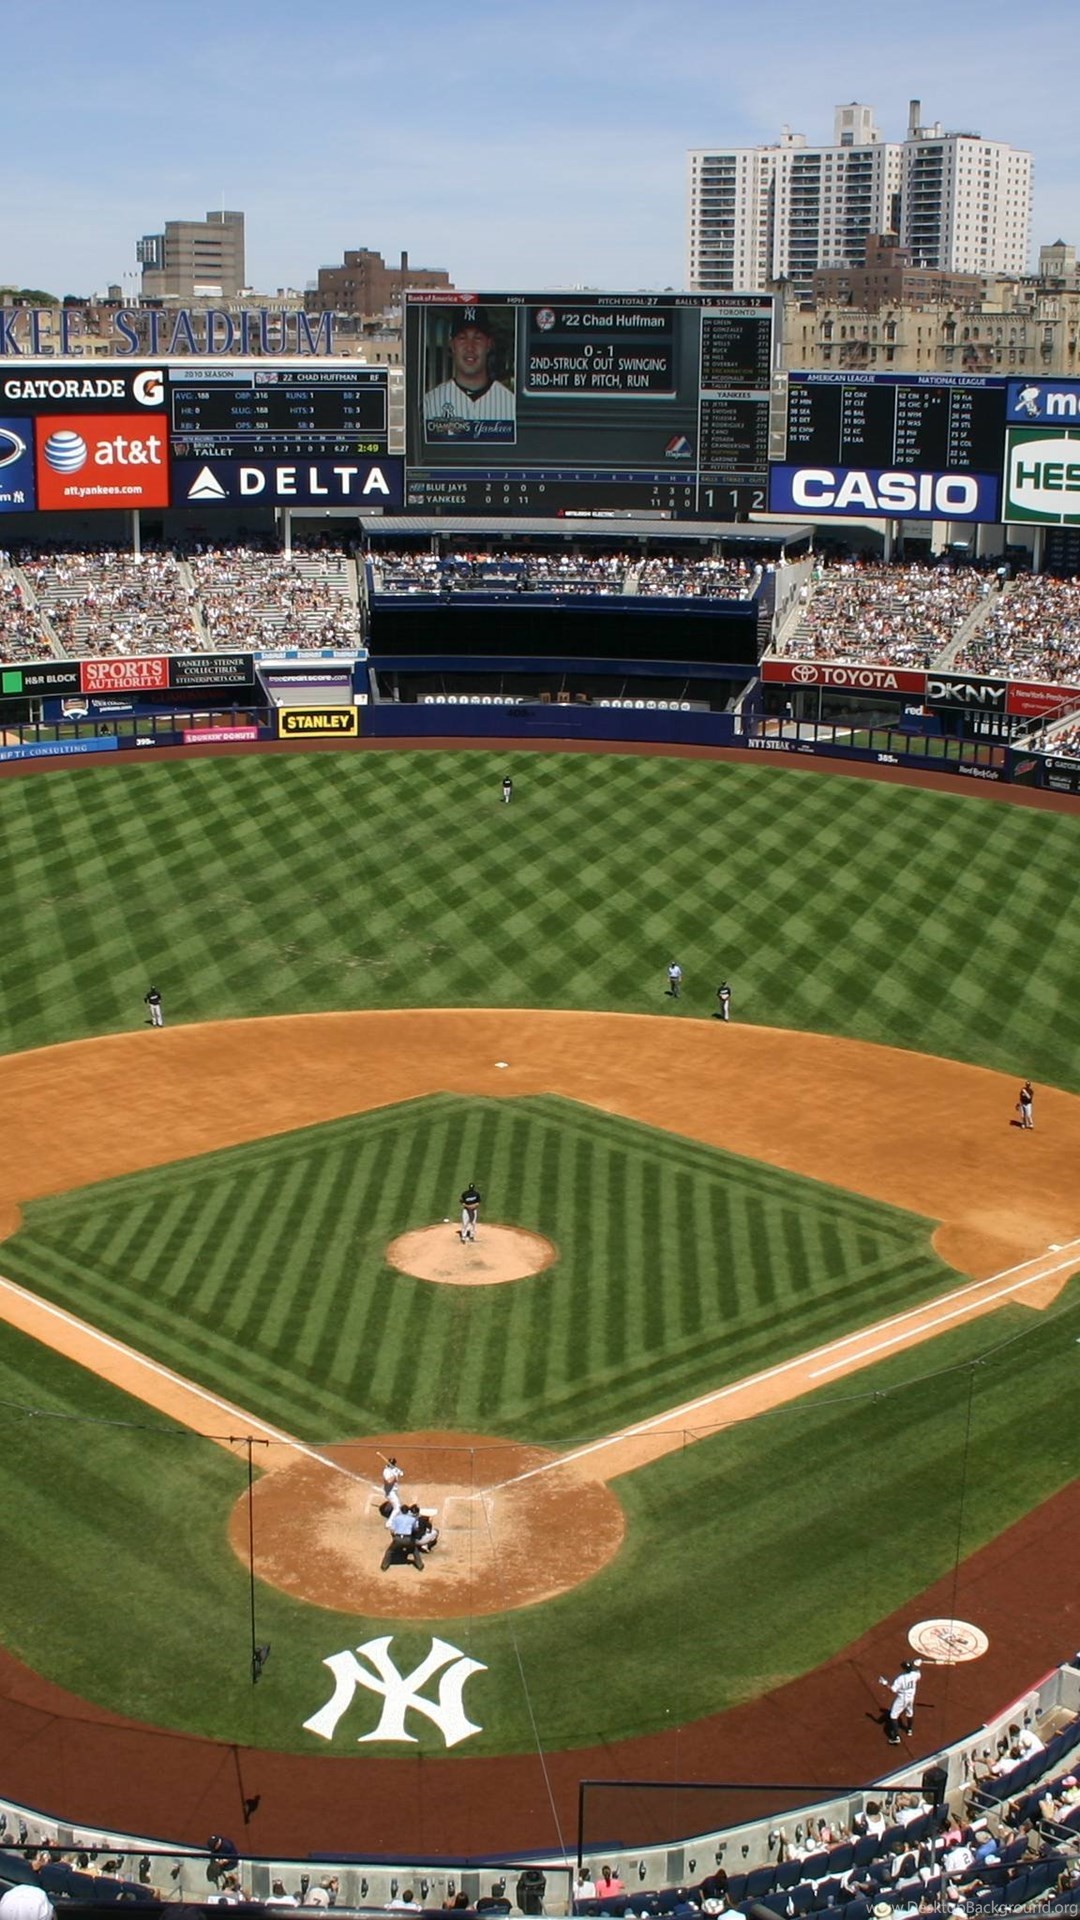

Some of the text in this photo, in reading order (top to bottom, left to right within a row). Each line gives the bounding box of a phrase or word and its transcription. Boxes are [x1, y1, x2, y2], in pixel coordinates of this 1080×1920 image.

[646, 298, 659, 306] 27
[702, 298, 713, 307] 15
[750, 299, 762, 308] 12
[719, 309, 756, 317] TORONTO
[561, 314, 665, 328] #22 Chad Huffman
[114, 309, 338, 357] STADIUM
[584, 345, 593, 358] 0
[607, 345, 614, 358] 1
[530, 357, 667, 371] 2ND-STRUCK OUT SWINGING
[184, 370, 234, 379] 2010 SEASON
[282, 374, 358, 382] 22 CHAD HUFFMAN
[530, 373, 650, 389] 3RD-HIT BY PITCH, RUN
[807, 374, 876, 383] AMERICAN LEAGUE
[918, 376, 987, 386] NATIONAL LEAGUE
[4, 380, 126, 399] GATORADE
[133, 371, 165, 406] G
[717, 392, 752, 400] YANKEES
[94, 435, 162, 466] at&t
[194, 448, 234, 457] TALLET
[307, 445, 314, 453] 0
[357, 444, 379, 453] 2:49
[239, 467, 391, 495] DELTA
[64, 485, 143, 498] att.yankees.com
[426, 483, 446, 492] BLUE
[447, 483, 468, 493] JAYS
[485, 483, 492, 492] 2
[503, 484, 510, 492] 0
[520, 484, 527, 492] 0
[539, 484, 546, 493] 0
[669, 487, 675, 495] 3
[684, 487, 691, 496] 0
[792, 469, 979, 514] CASIO
[426, 495, 466, 504] YANKEES
[485, 496, 492, 504] 0
[503, 496, 510, 504] 0
[519, 496, 529, 504] 11
[651, 499, 661, 507] 11
[684, 500, 691, 508] 0
[705, 489, 765, 509] 1 1 2
[86, 660, 163, 681] SPORTS
[184, 666, 238, 675] COLLECTIBLES
[24, 674, 78, 685] H&R BLOCK
[176, 675, 246, 684] STEINERSPORTS.COM
[821, 668, 898, 689] TOYOTA
[927, 681, 1006, 705] DKNY
[287, 715, 350, 729] STANLEY
[223, 731, 255, 740] DONUTS
[974, 722, 1018, 738] IMAGE
[29, 744, 88, 757] CONSULTING
[766, 739, 790, 751] STEAK
[959, 765, 999, 780] Hard Rock Cafe
[302, 1635, 488, 1748] NY
